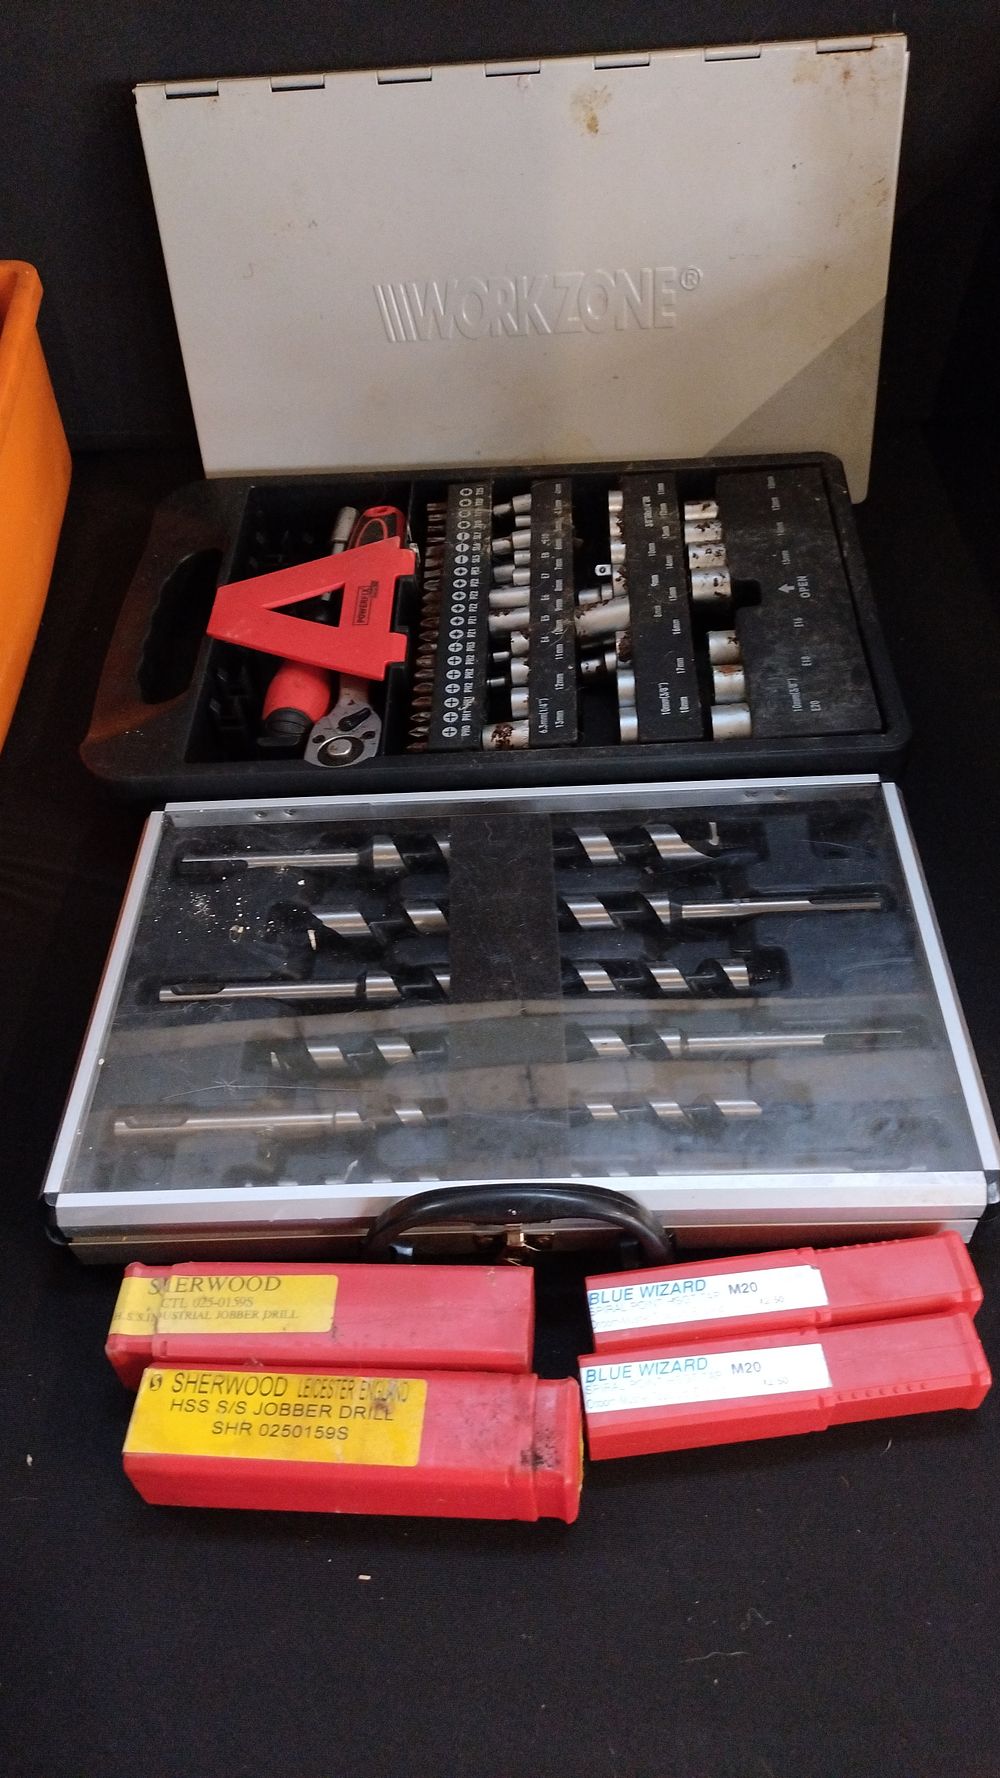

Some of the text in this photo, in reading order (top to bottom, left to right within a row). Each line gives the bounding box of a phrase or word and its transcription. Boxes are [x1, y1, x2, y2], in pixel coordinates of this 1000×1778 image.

[796, 575, 811, 599] OPEN
[555, 643, 564, 660] 11mm
[676, 657, 685, 674] 17mm
[555, 673, 564, 690] 12mm
[555, 710, 564, 728] 13mm
[588, 1288, 634, 1305] BLUE
[639, 1279, 706, 1298] WIZARD
[728, 1281, 758, 1295] M20
[161, 1297, 187, 1308] CTL
[215, 1311, 259, 1320] JOBBER
[262, 1309, 299, 1321] DRILL
[585, 1365, 632, 1383] BLUE
[638, 1357, 708, 1377] WIZARD
[731, 1361, 762, 1375] M20
[171, 1372, 288, 1397] SHERWOOD
[170, 1398, 394, 1421] HSS S/S JOBBER DRILL
[211, 1421, 349, 1440] SHR 0250159S
